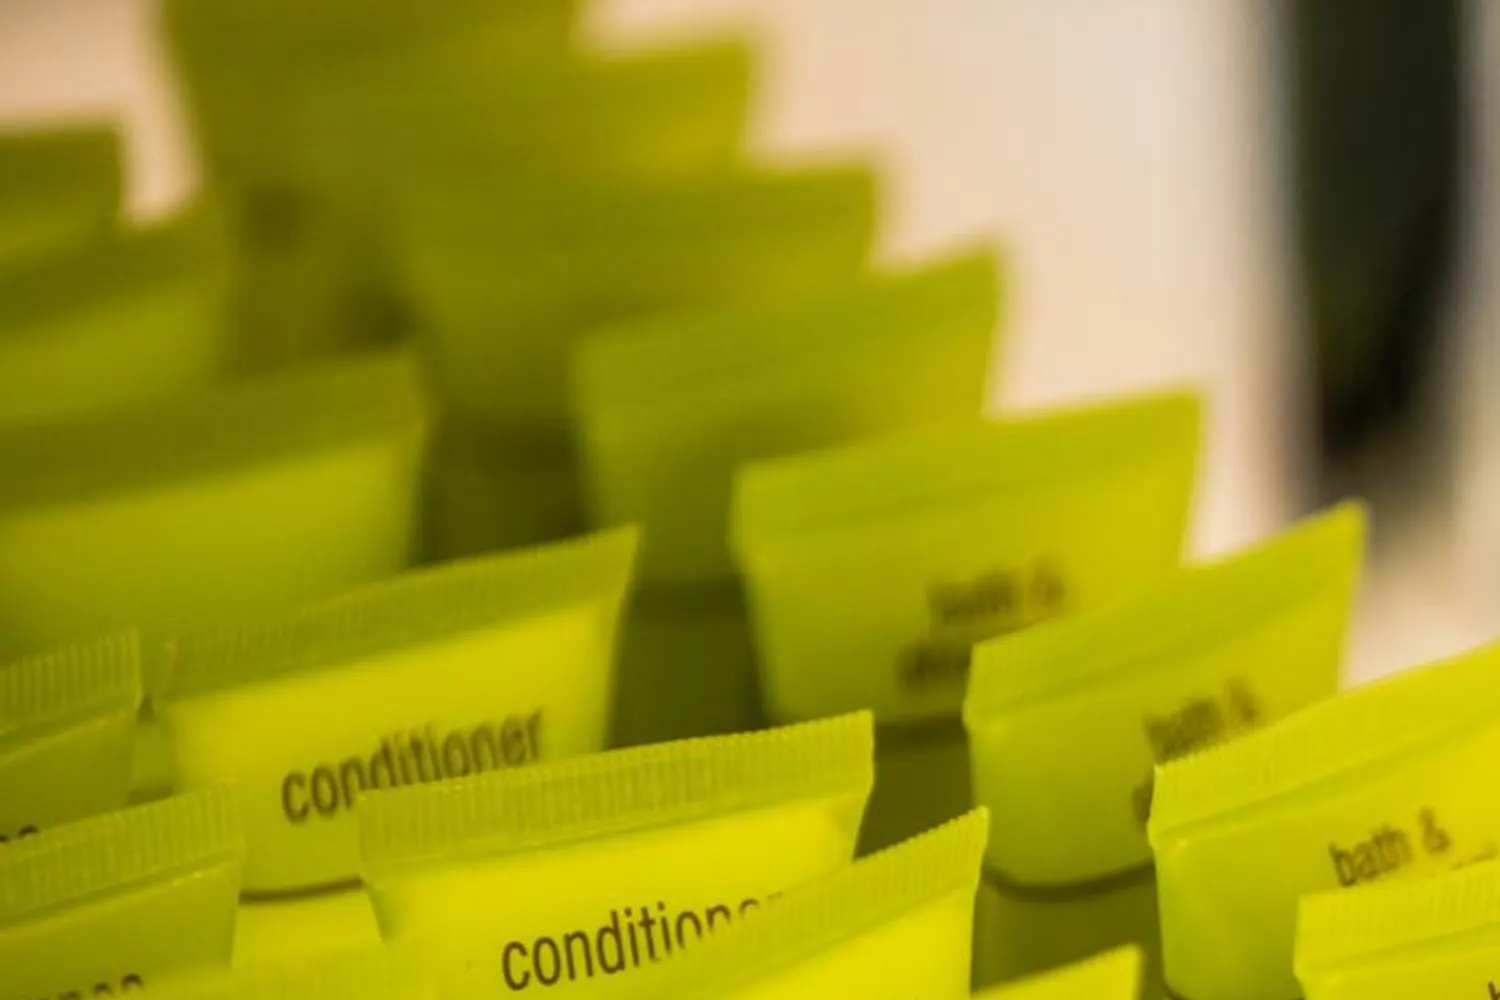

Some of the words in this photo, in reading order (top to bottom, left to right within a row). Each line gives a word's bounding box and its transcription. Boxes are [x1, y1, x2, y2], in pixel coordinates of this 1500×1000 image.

[281, 706, 544, 826] conditioner
[1328, 820, 1414, 887] bath
[501, 890, 784, 991] condition
